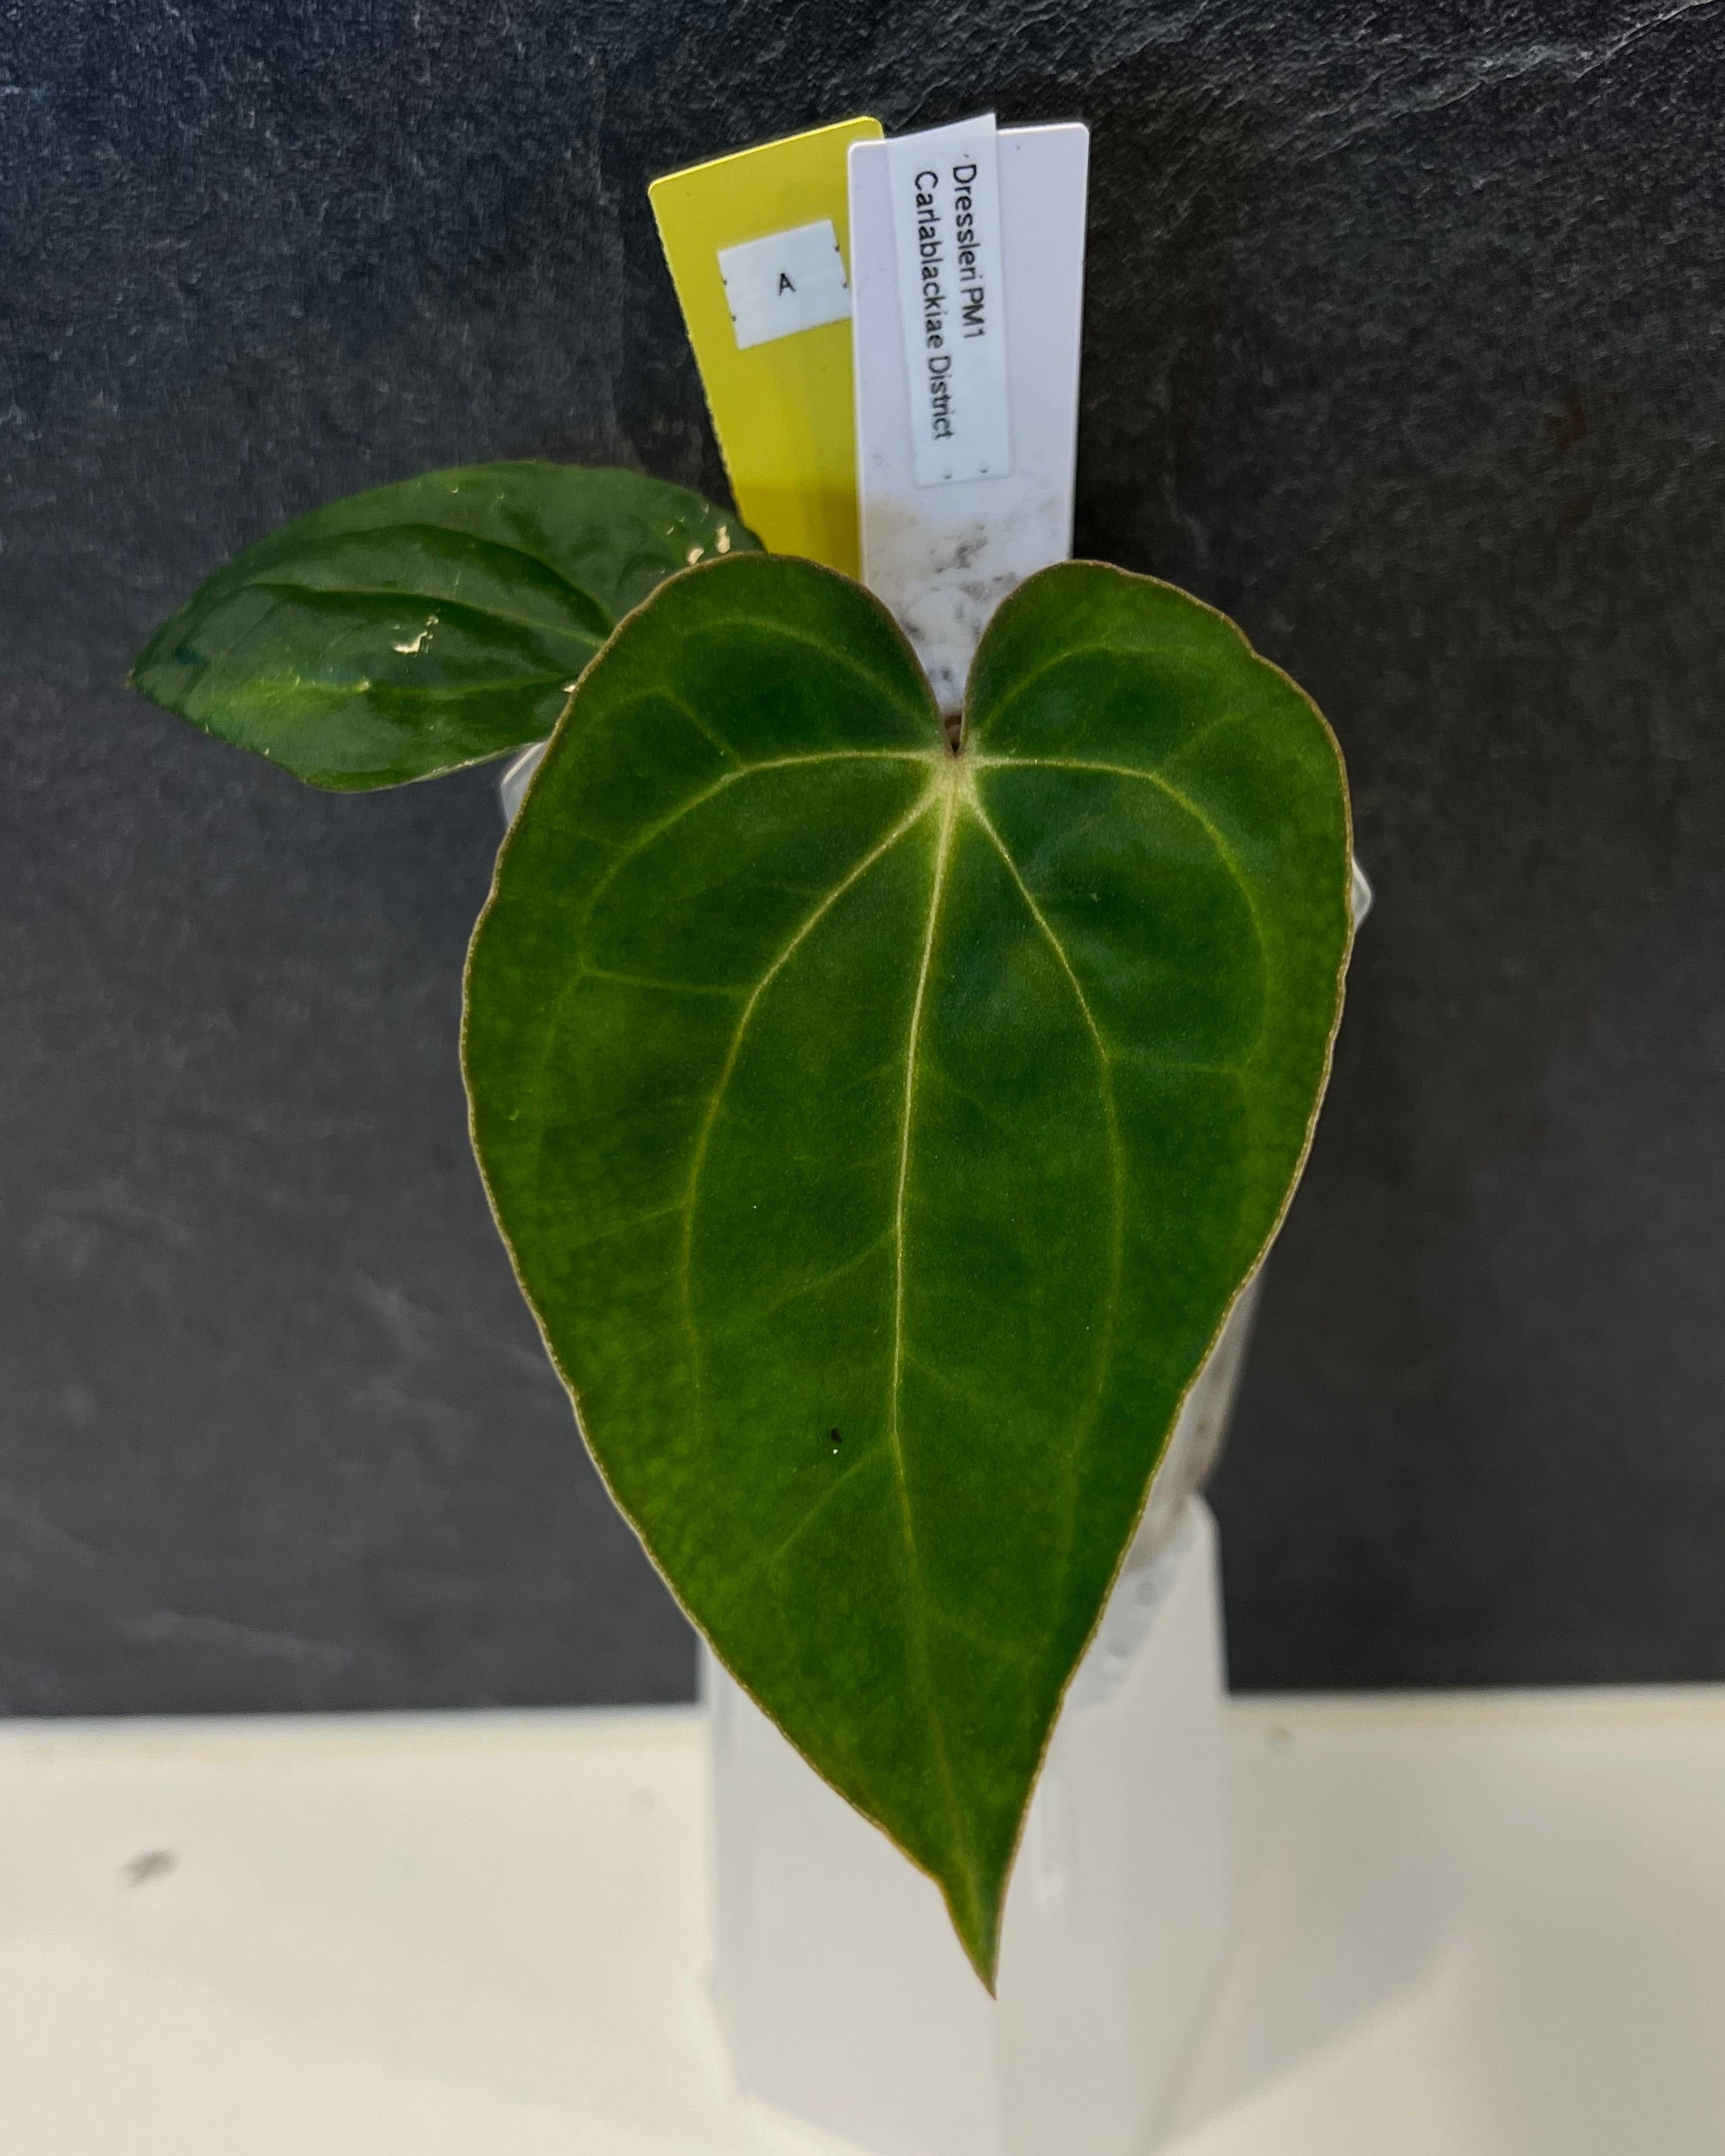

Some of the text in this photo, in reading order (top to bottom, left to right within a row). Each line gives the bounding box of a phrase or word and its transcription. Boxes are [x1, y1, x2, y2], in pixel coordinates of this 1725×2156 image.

[779, 272, 796, 297] A
[914, 170, 955, 441] Carlablackiae District
[952, 163, 986, 338] Dressleri PM1
